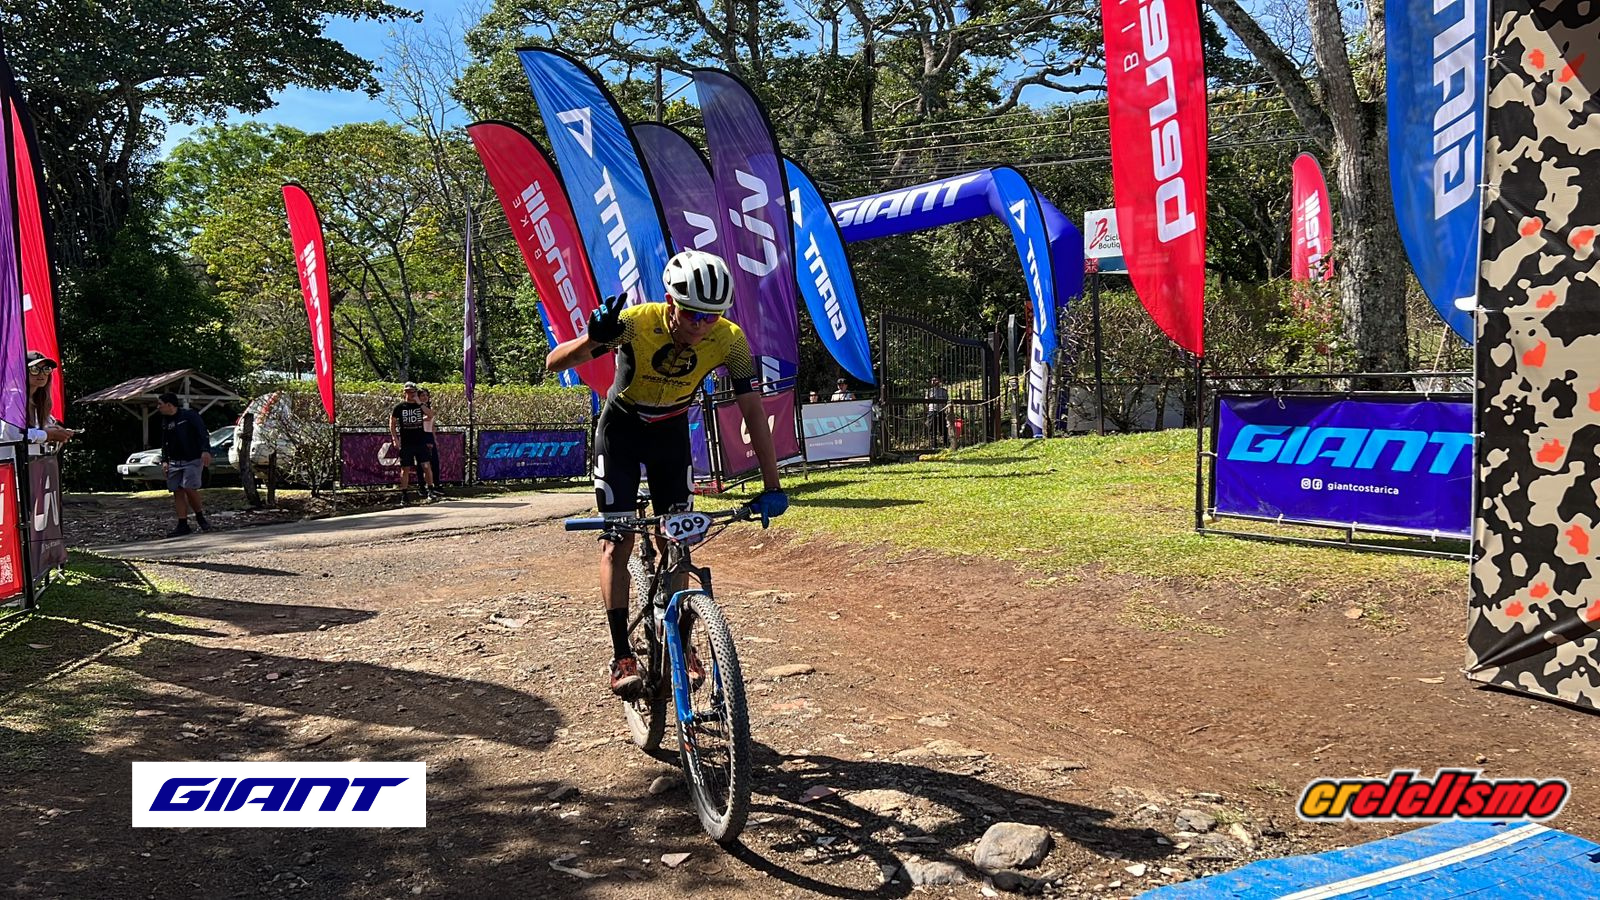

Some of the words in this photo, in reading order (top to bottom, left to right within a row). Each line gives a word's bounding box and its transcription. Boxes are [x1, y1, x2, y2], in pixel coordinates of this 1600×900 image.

[829, 173, 982, 228] GIANT
[728, 169, 778, 277] Liv
[1098, 242, 1121, 250] Boutiq
[1104, 233, 1121, 242] Cicl
[402, 408, 421, 416] BIKE
[402, 415, 422, 423] RIDE
[485, 441, 580, 459] GIANT
[1227, 423, 1473, 475] GIANT
[1327, 481, 1400, 496] giantcostarica
[34, 475, 59, 532] Liv
[669, 516, 705, 537] 209
